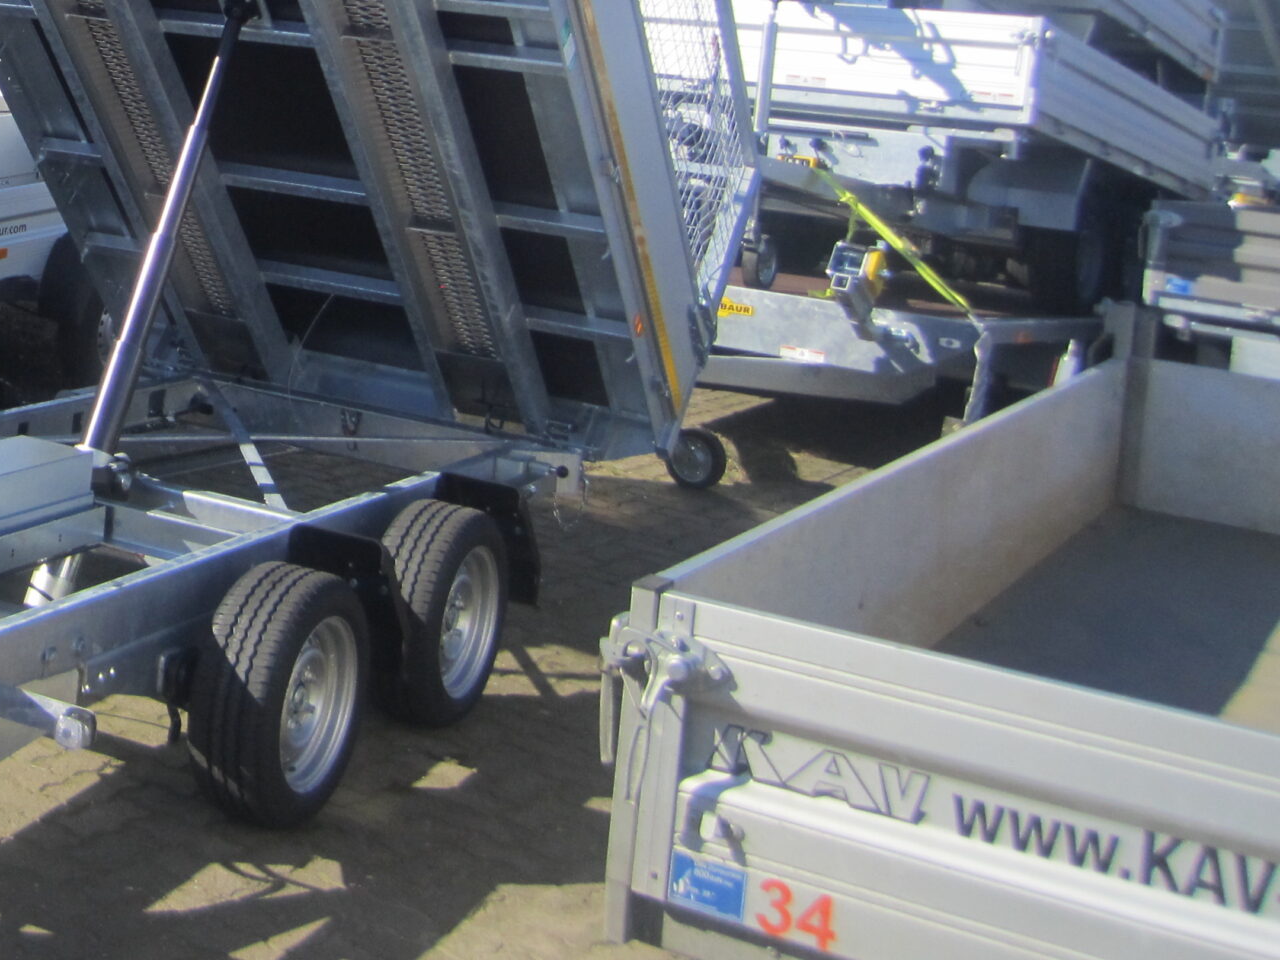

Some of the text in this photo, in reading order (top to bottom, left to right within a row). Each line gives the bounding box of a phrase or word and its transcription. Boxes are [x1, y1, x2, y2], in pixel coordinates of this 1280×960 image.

[720, 303, 751, 314] BAUR
[952, 793, 1280, 915] www.KAV
[755, 877, 837, 951] 34
